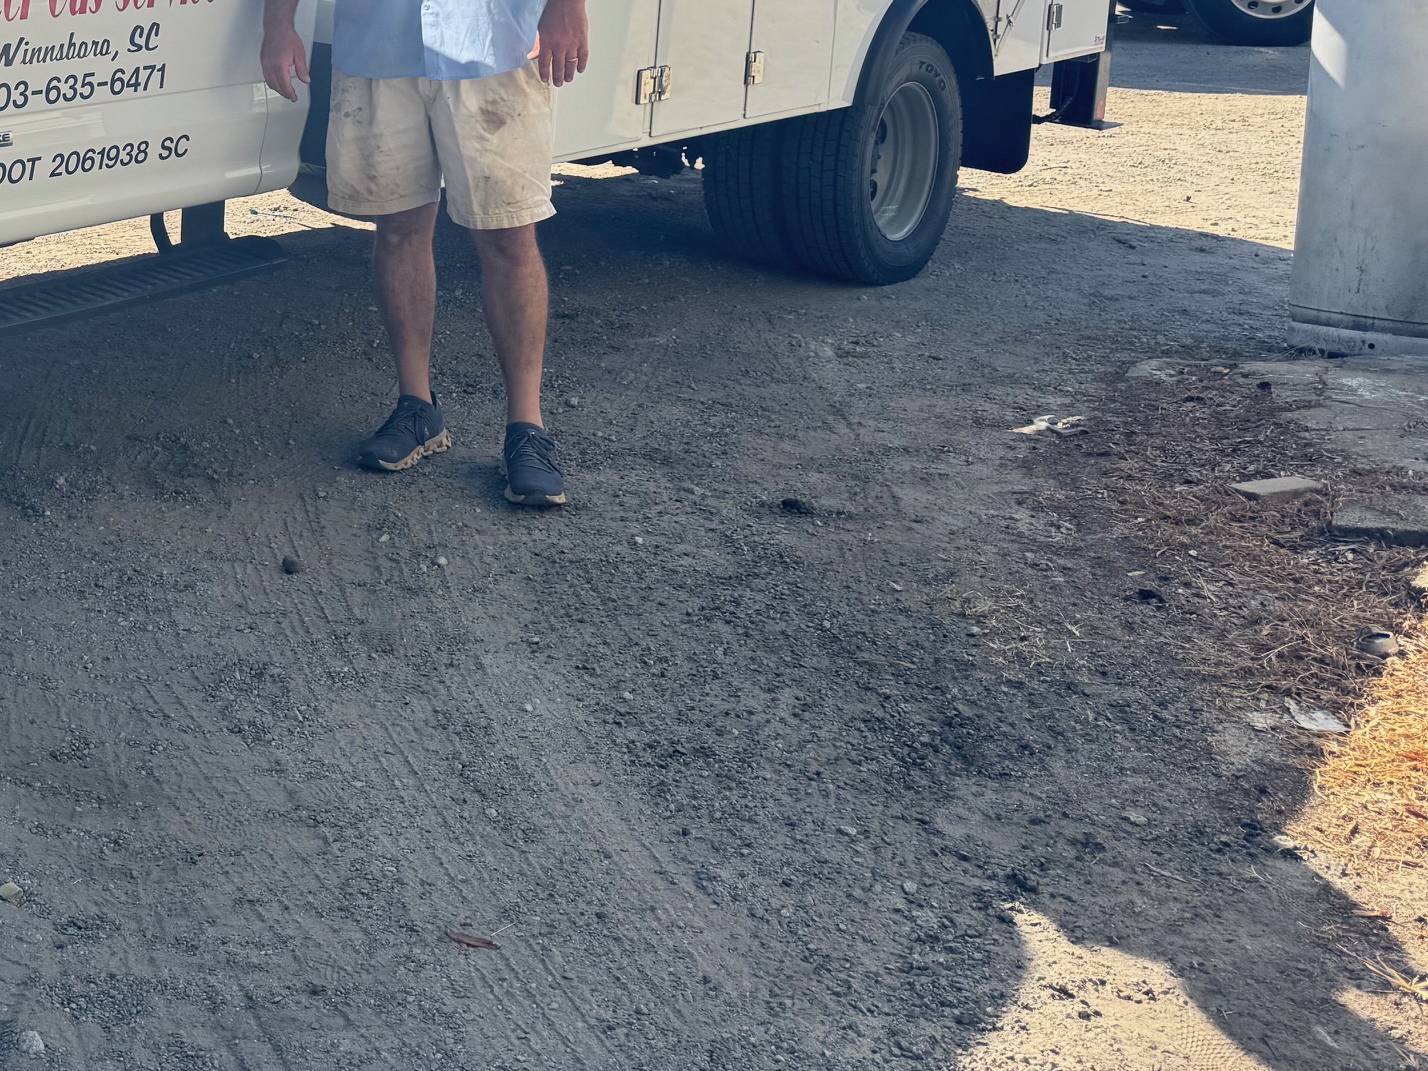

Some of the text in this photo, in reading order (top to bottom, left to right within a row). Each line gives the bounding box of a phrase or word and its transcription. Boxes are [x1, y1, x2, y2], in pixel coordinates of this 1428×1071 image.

[127, 21, 161, 53] SC
[918, 60, 947, 91] TOYO
[49, 140, 150, 178] 2061938
[158, 134, 190, 161] SC
